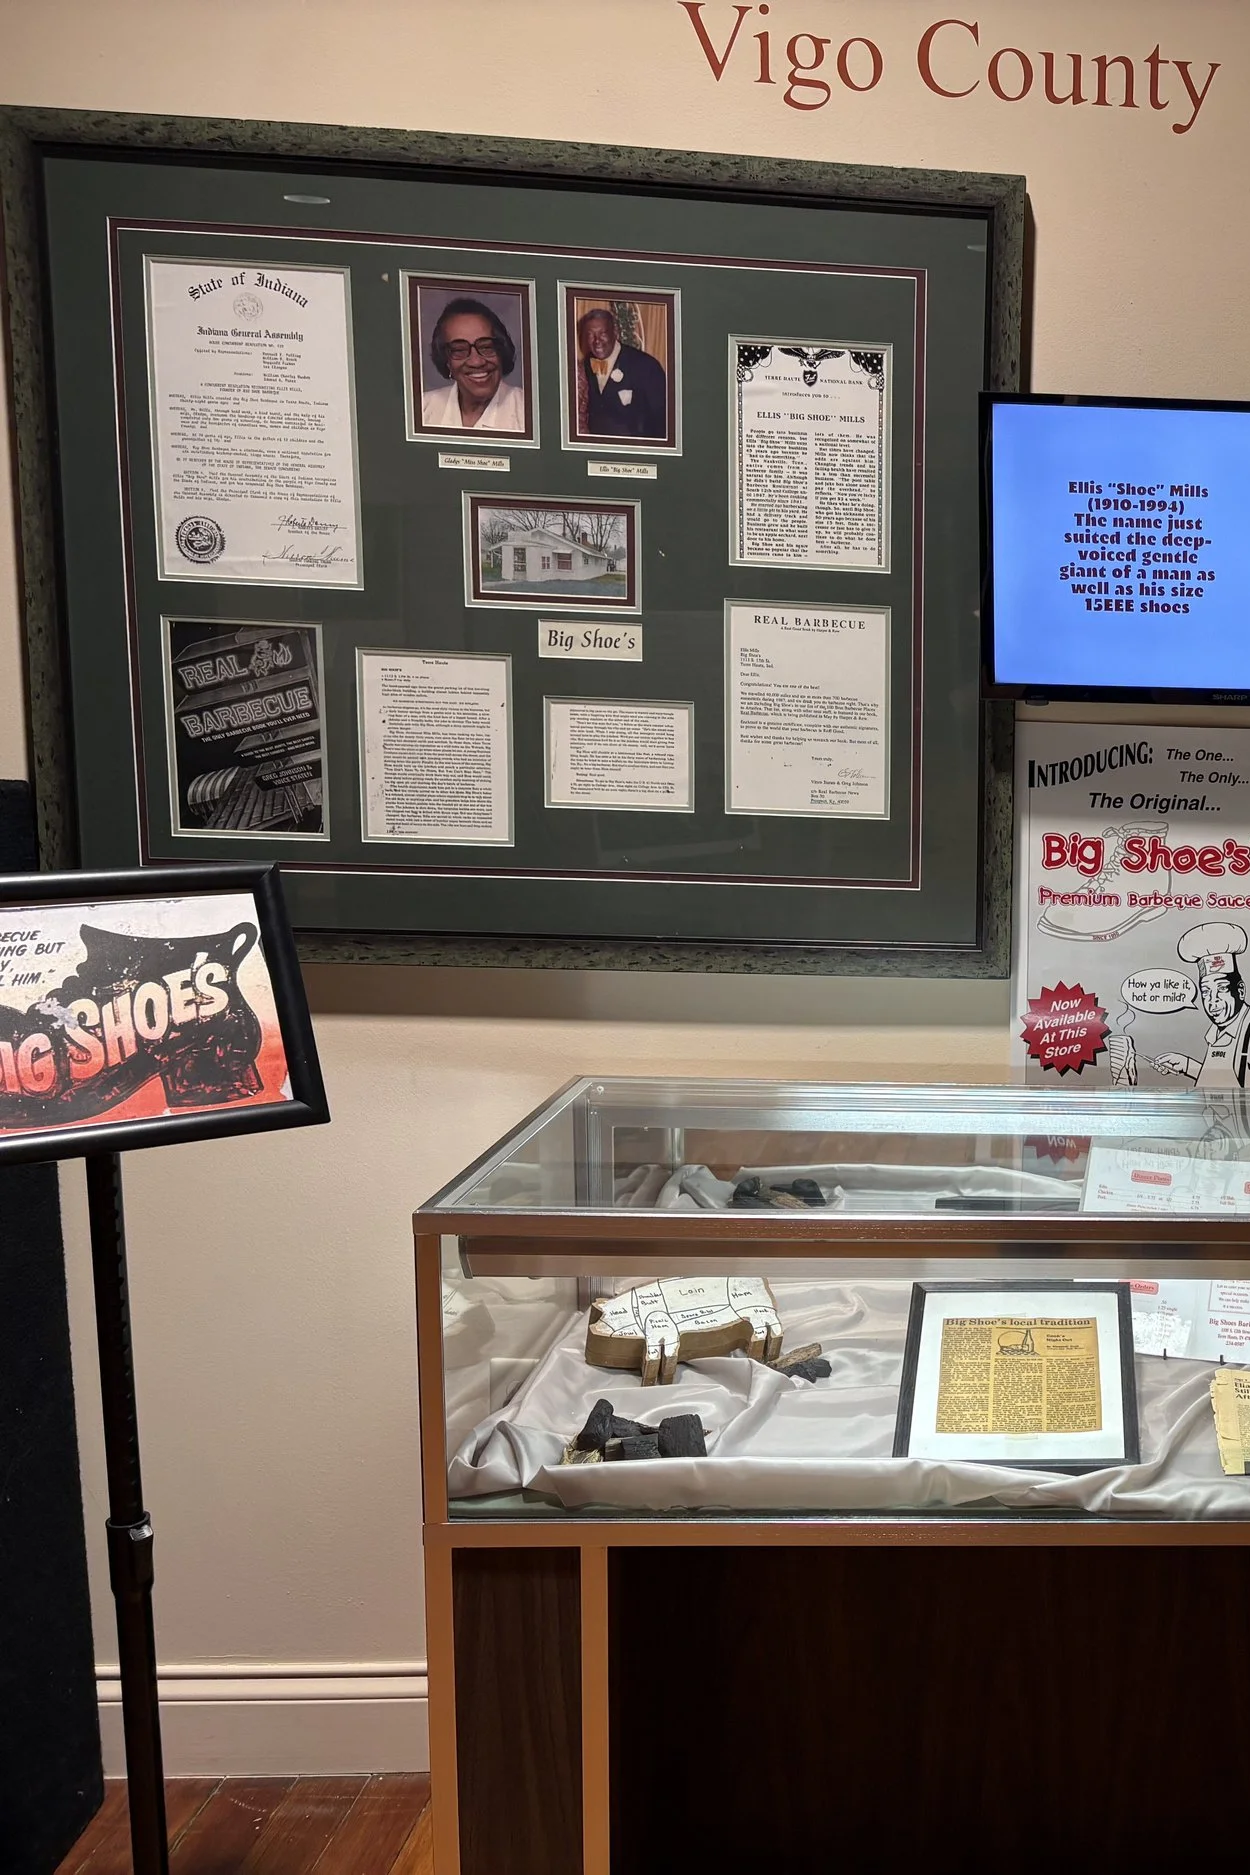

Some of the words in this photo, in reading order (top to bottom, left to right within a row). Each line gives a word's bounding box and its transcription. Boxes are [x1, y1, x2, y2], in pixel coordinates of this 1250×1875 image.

[677, 1, 883, 111] Vigo
[917, 19, 1221, 135] County
[188, 277, 223, 302] State
[231, 272, 246, 286] of
[254, 272, 309, 308] Indiana
[196, 326, 228, 337] Indiana
[231, 328, 262, 339] General
[264, 330, 304, 342] Assembly
[756, 411, 781, 420] ELLIS
[783, 413, 805, 421] "BIG
[807, 414, 837, 422] SHOE"
[839, 415, 866, 424] MILLS
[1068, 480, 1103, 495] Ellis
[1169, 483, 1209, 498] Mills
[1087, 498, 1185, 516] (1910-1994)
[1073, 513, 1107, 527] The
[1112, 516, 1163, 529] name
[1167, 514, 1203, 532] just
[1064, 528, 1121, 545] suited
[1126, 531, 1157, 546] the
[1162, 533, 1212, 551] deep-
[1077, 546, 1137, 563] voiced
[1141, 550, 1198, 566] gentle
[1059, 562, 1107, 581] giant
[1111, 564, 1132, 580] of
[1136, 568, 1147, 580] a
[1152, 568, 1192, 581] man
[1196, 569, 1216, 582] as
[1071, 581, 1109, 595] well
[1114, 584, 1134, 596] as
[1139, 581, 1166, 597] his
[1171, 582, 1205, 598] size
[1085, 598, 1135, 613] 15EEE
[1140, 599, 1190, 614] shoes
[754, 614, 789, 626] REAL
[794, 617, 866, 630] BARBECUE
[548, 629, 574, 652] Big
[581, 629, 636, 650] Shoe's
[177, 654, 249, 690] REAL
[1212, 693, 1248, 701] SHARP
[179, 686, 314, 739] BARBECUE
[1028, 741, 1154, 788] INTRODUCING:
[1166, 748, 1191, 761] The
[1195, 749, 1234, 762] One...
[261, 772, 279, 782] GREG
[279, 765, 306, 778] JOHNSON
[273, 775, 289, 786] VINCE
[289, 771, 313, 782] STATEN
[1179, 771, 1205, 783] The
[1208, 772, 1250, 787] Only...
[1089, 792, 1124, 809] The
[1129, 793, 1221, 814] Original...
[1042, 832, 1105, 877] Big
[1038, 885, 1121, 908] Premium
[1127, 890, 1204, 911] Barbeque
[0, 930, 41, 943] ECUE
[1092, 934, 1108, 942] SINCE
[35, 942, 66, 955] BUT
[1128, 979, 1148, 990] How
[1150, 981, 1161, 993] ya
[1163, 978, 1180, 990] like
[1181, 979, 1191, 991] it,
[1051, 997, 1082, 1013] Now
[1132, 991, 1147, 1003] hot
[1149, 994, 1161, 1003] or
[1163, 991, 1187, 1003] mild?
[1033, 1008, 1096, 1032] Available
[1040, 1031, 1058, 1046] At
[1058, 1026, 1088, 1042] This
[1044, 1043, 1082, 1060] Store
[1211, 1051, 1227, 1059] SHOE
[609, 1307, 628, 1316] Head
[946, 1318, 966, 1328] Big
[969, 1318, 1007, 1326] Shoe's
[1010, 1318, 1037, 1326] local
[1040, 1318, 1091, 1326] tradition
[1209, 1318, 1220, 1327] Big
[1220, 1319, 1237, 1327] Shoes
